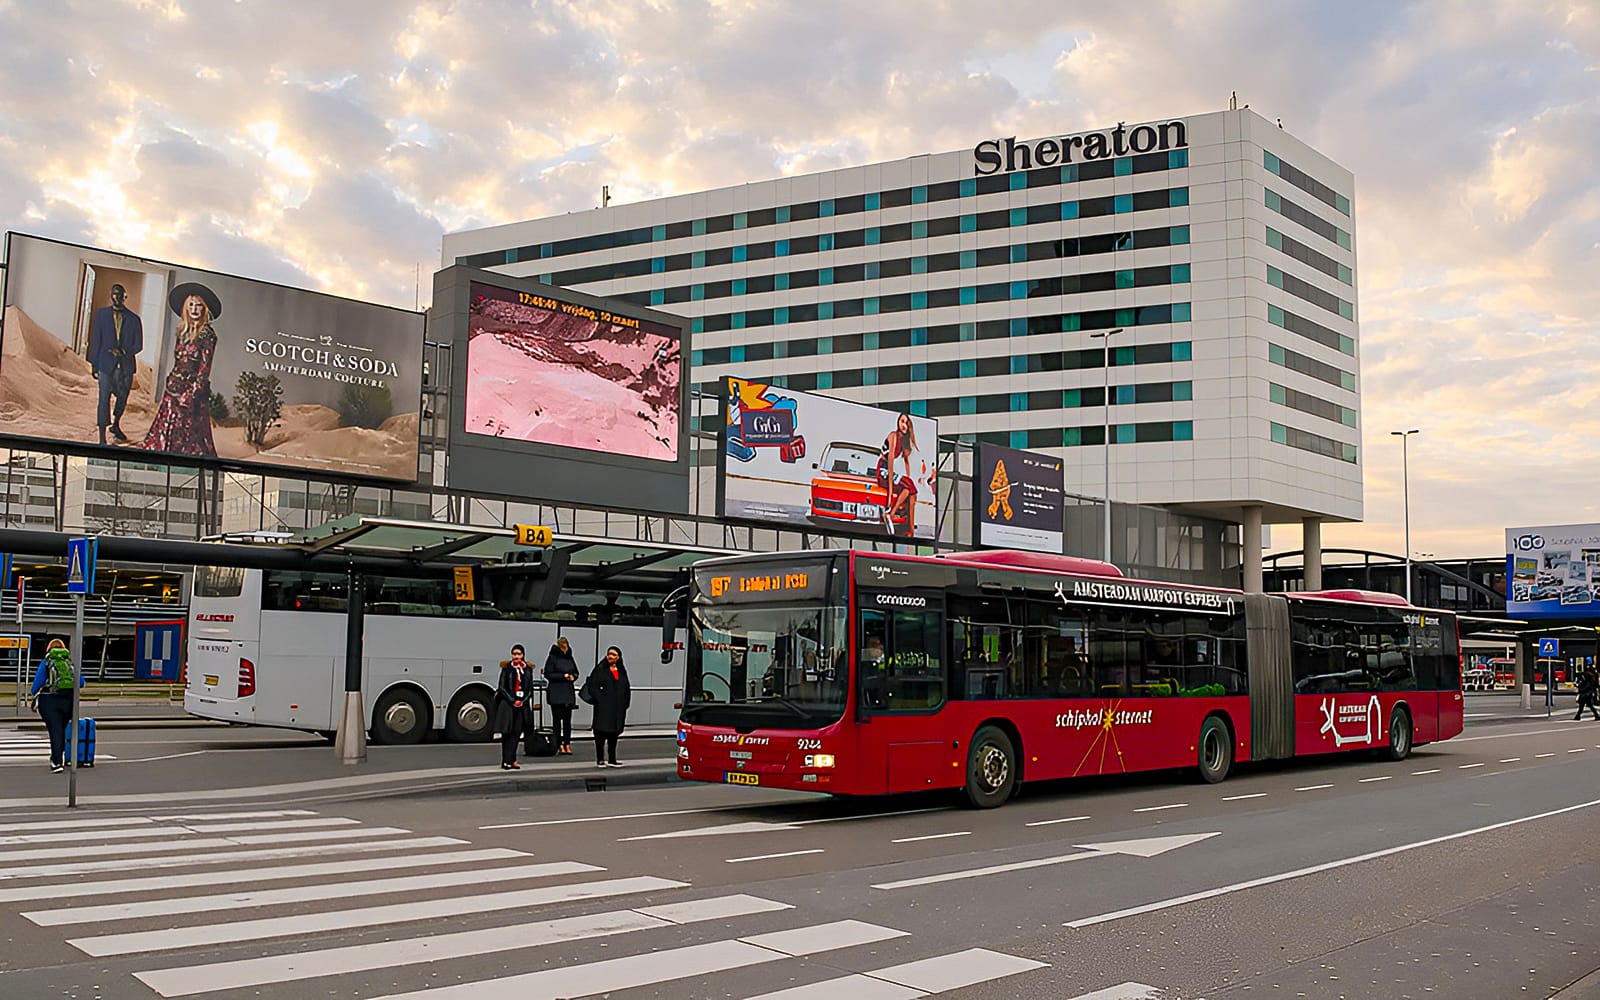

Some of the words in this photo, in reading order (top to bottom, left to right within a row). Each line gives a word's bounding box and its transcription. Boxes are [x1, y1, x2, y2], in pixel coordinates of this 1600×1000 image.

[974, 119, 1189, 177] Sheraton
[245, 337, 329, 366] SCOTCH
[347, 354, 399, 377] SODA
[262, 360, 332, 380] AMSTERDAM
[526, 528, 545, 544] B4
[1073, 581, 1141, 602] AMSTERDAM
[1055, 707, 1104, 731] schiphol
[1115, 709, 1153, 725] sternet
